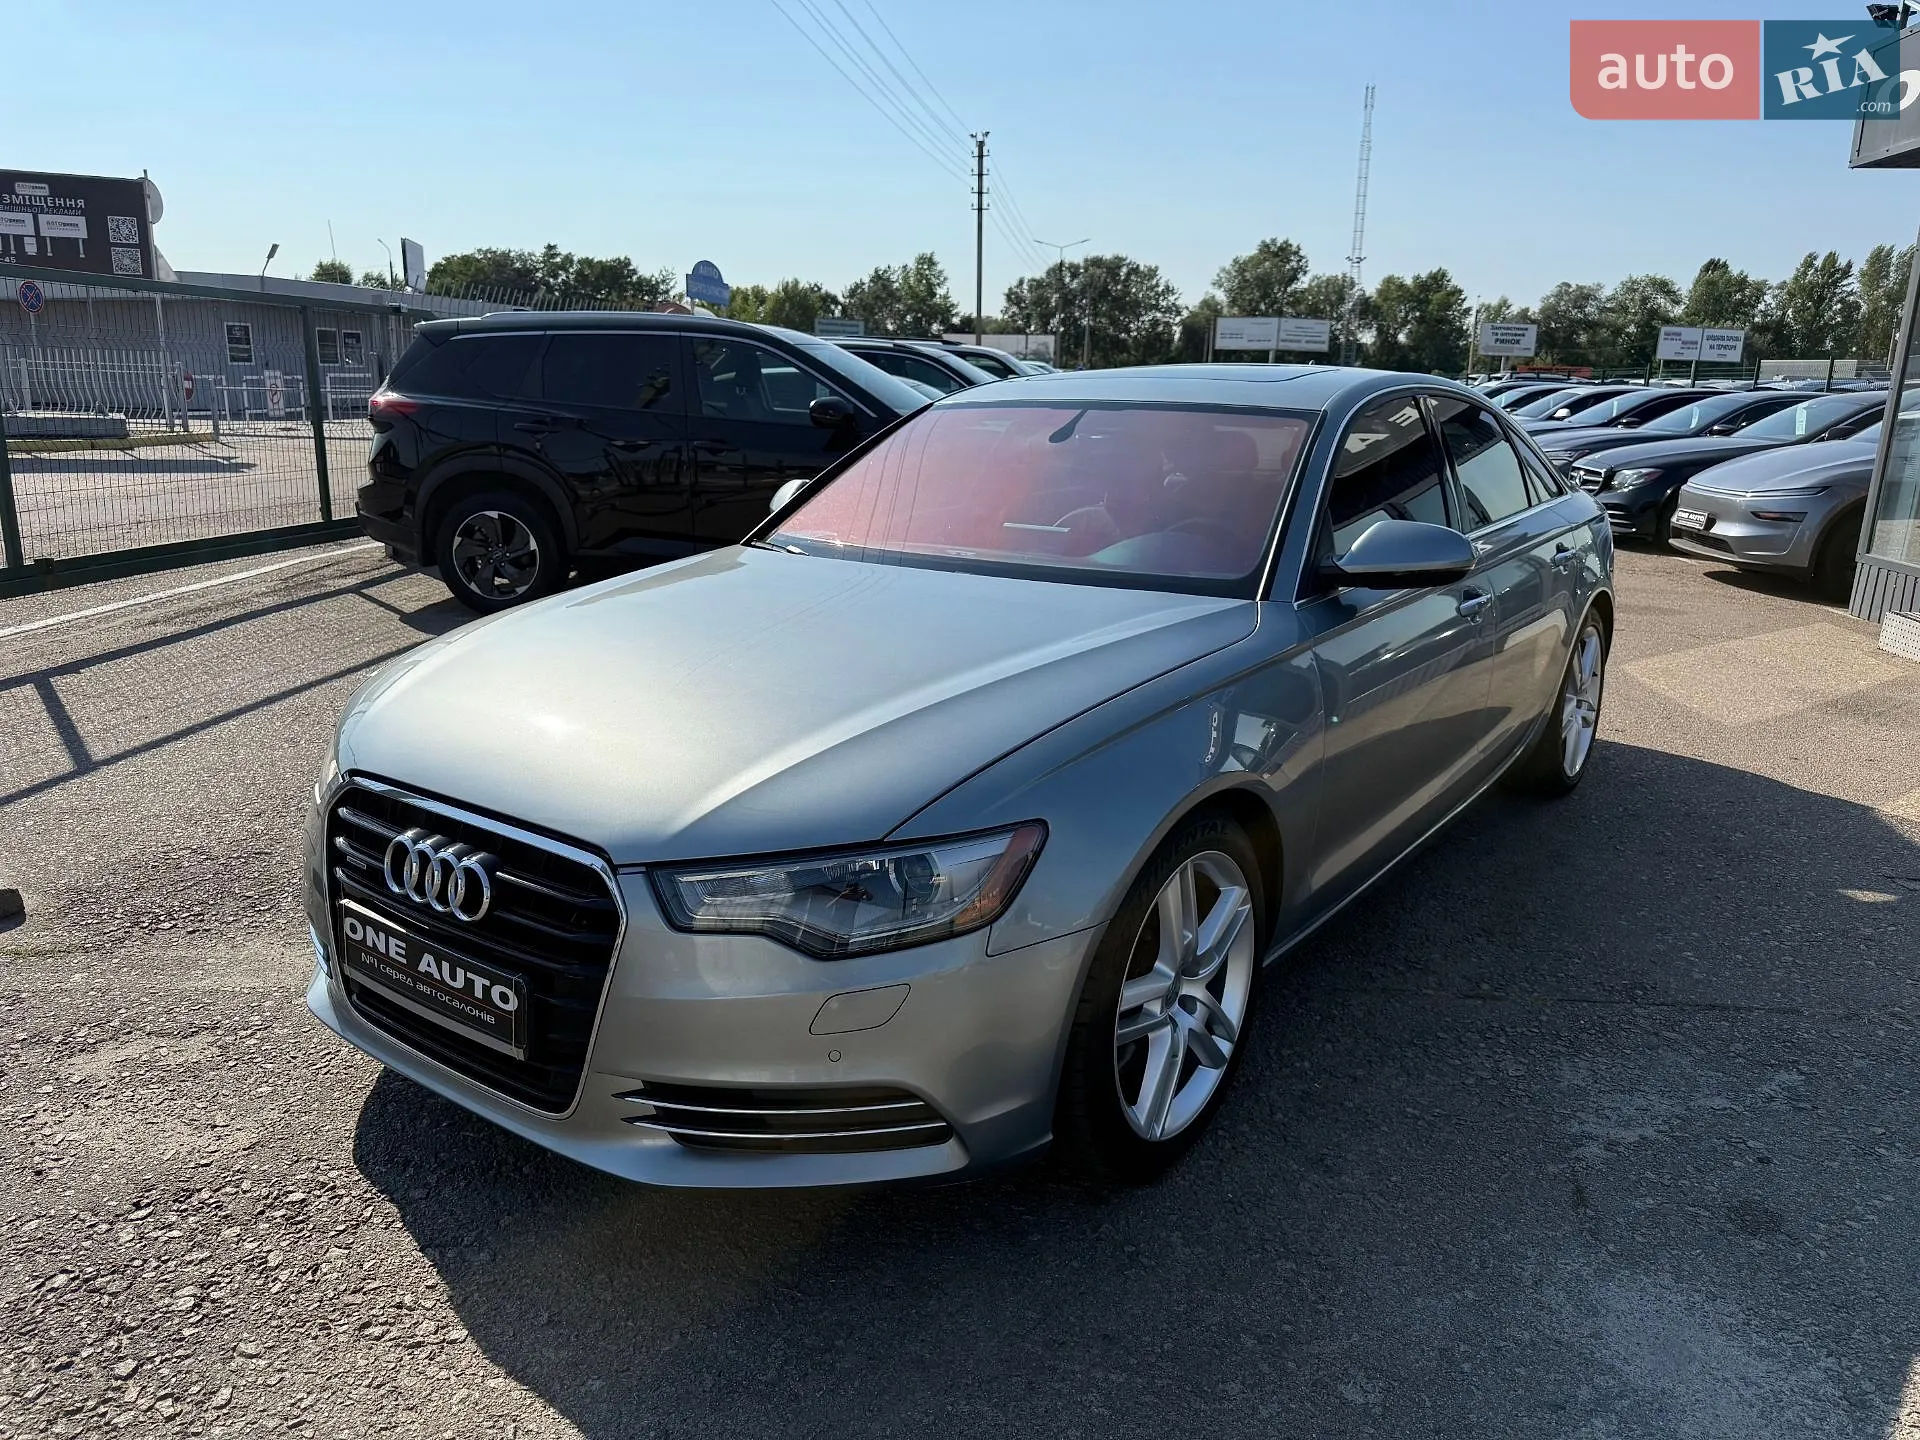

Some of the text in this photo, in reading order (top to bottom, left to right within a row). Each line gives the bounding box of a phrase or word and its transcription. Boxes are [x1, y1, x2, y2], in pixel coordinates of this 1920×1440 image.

[344, 917, 518, 1011] ONE AUTO
[380, 962, 414, 987] серед
[416, 982, 495, 1025] автосалонів
